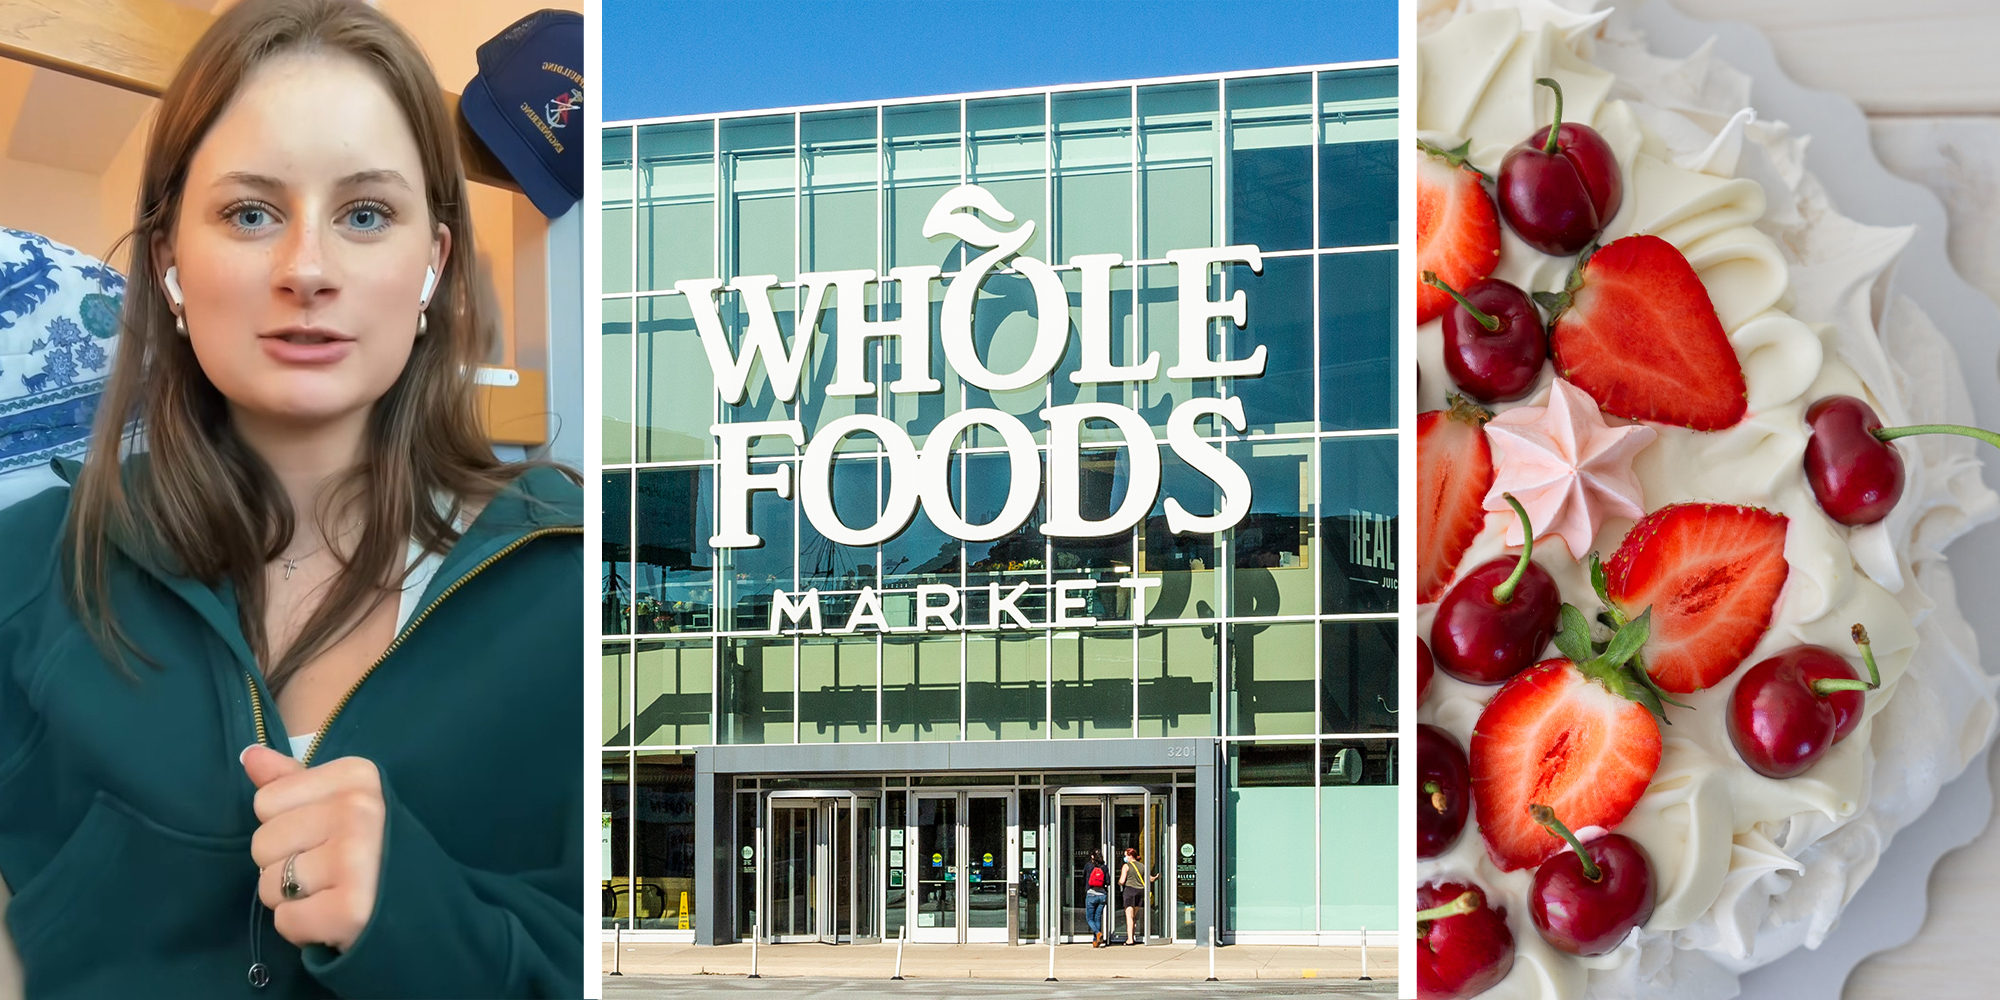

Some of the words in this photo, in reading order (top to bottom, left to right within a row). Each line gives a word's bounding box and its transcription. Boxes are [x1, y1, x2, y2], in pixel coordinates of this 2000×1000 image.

[674, 226, 1268, 405] WHOLE
[709, 396, 1253, 548] FOODS
[1349, 508, 1395, 571] REAL
[770, 577, 1161, 635] MARKET
[1167, 746, 1196, 757] 3201
